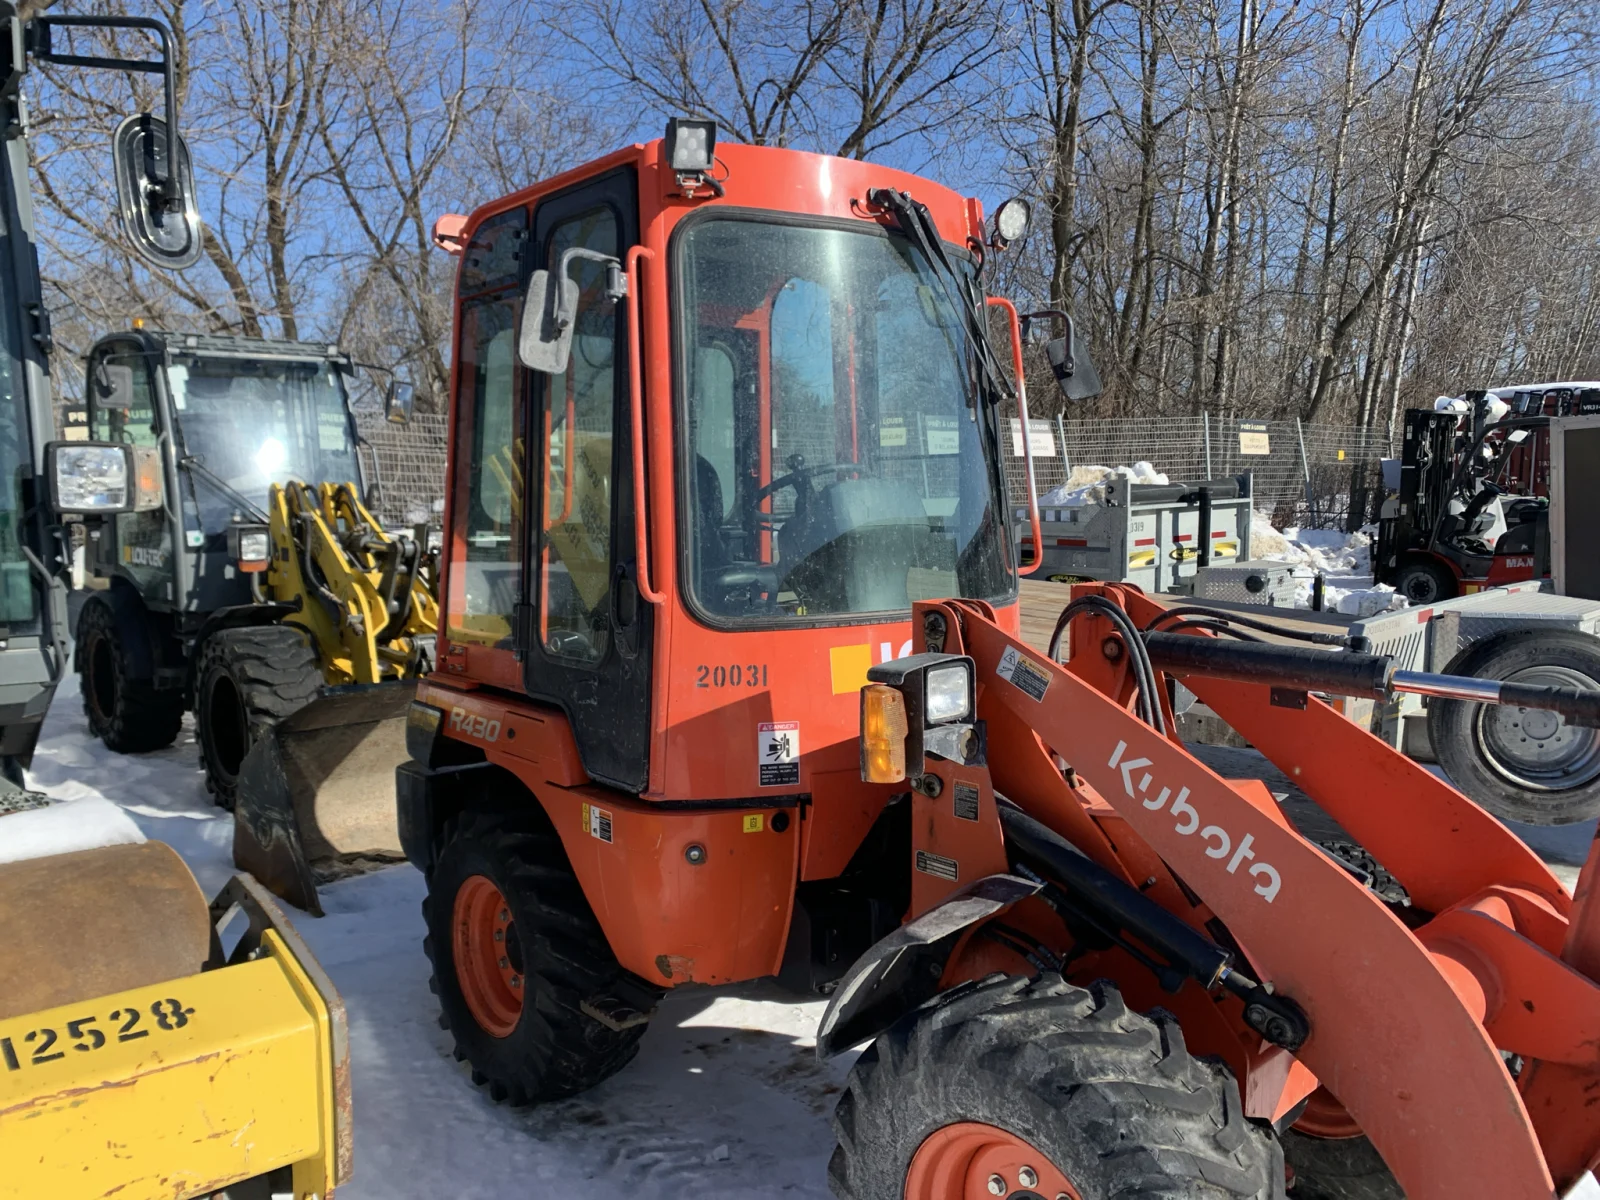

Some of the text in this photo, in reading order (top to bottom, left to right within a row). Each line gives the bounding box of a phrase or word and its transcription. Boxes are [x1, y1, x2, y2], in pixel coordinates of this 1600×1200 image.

[697, 664, 767, 688] 20031
[448, 706, 501, 742] R430
[768, 723, 795, 731] DANGER
[1107, 739, 1282, 903] Kubota
